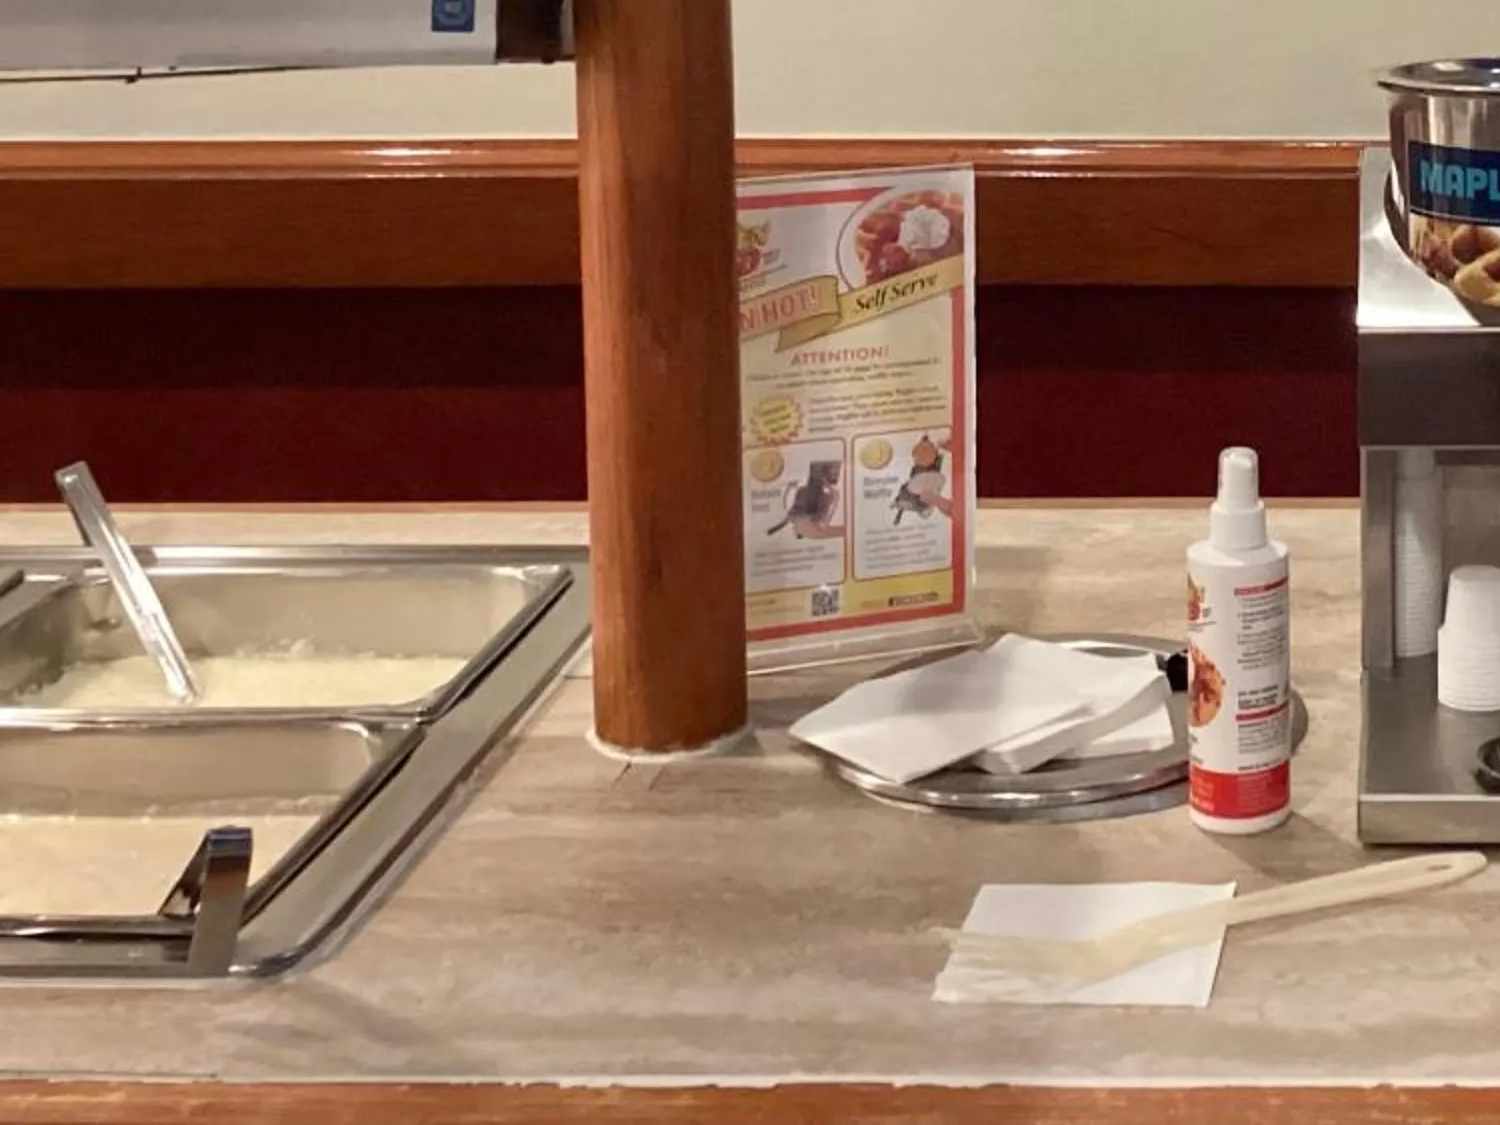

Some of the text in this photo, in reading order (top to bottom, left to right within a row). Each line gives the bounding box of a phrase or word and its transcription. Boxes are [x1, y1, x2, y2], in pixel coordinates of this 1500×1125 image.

[854, 273, 939, 313] Self Serve
[791, 345, 890, 366] ATTENTION!
